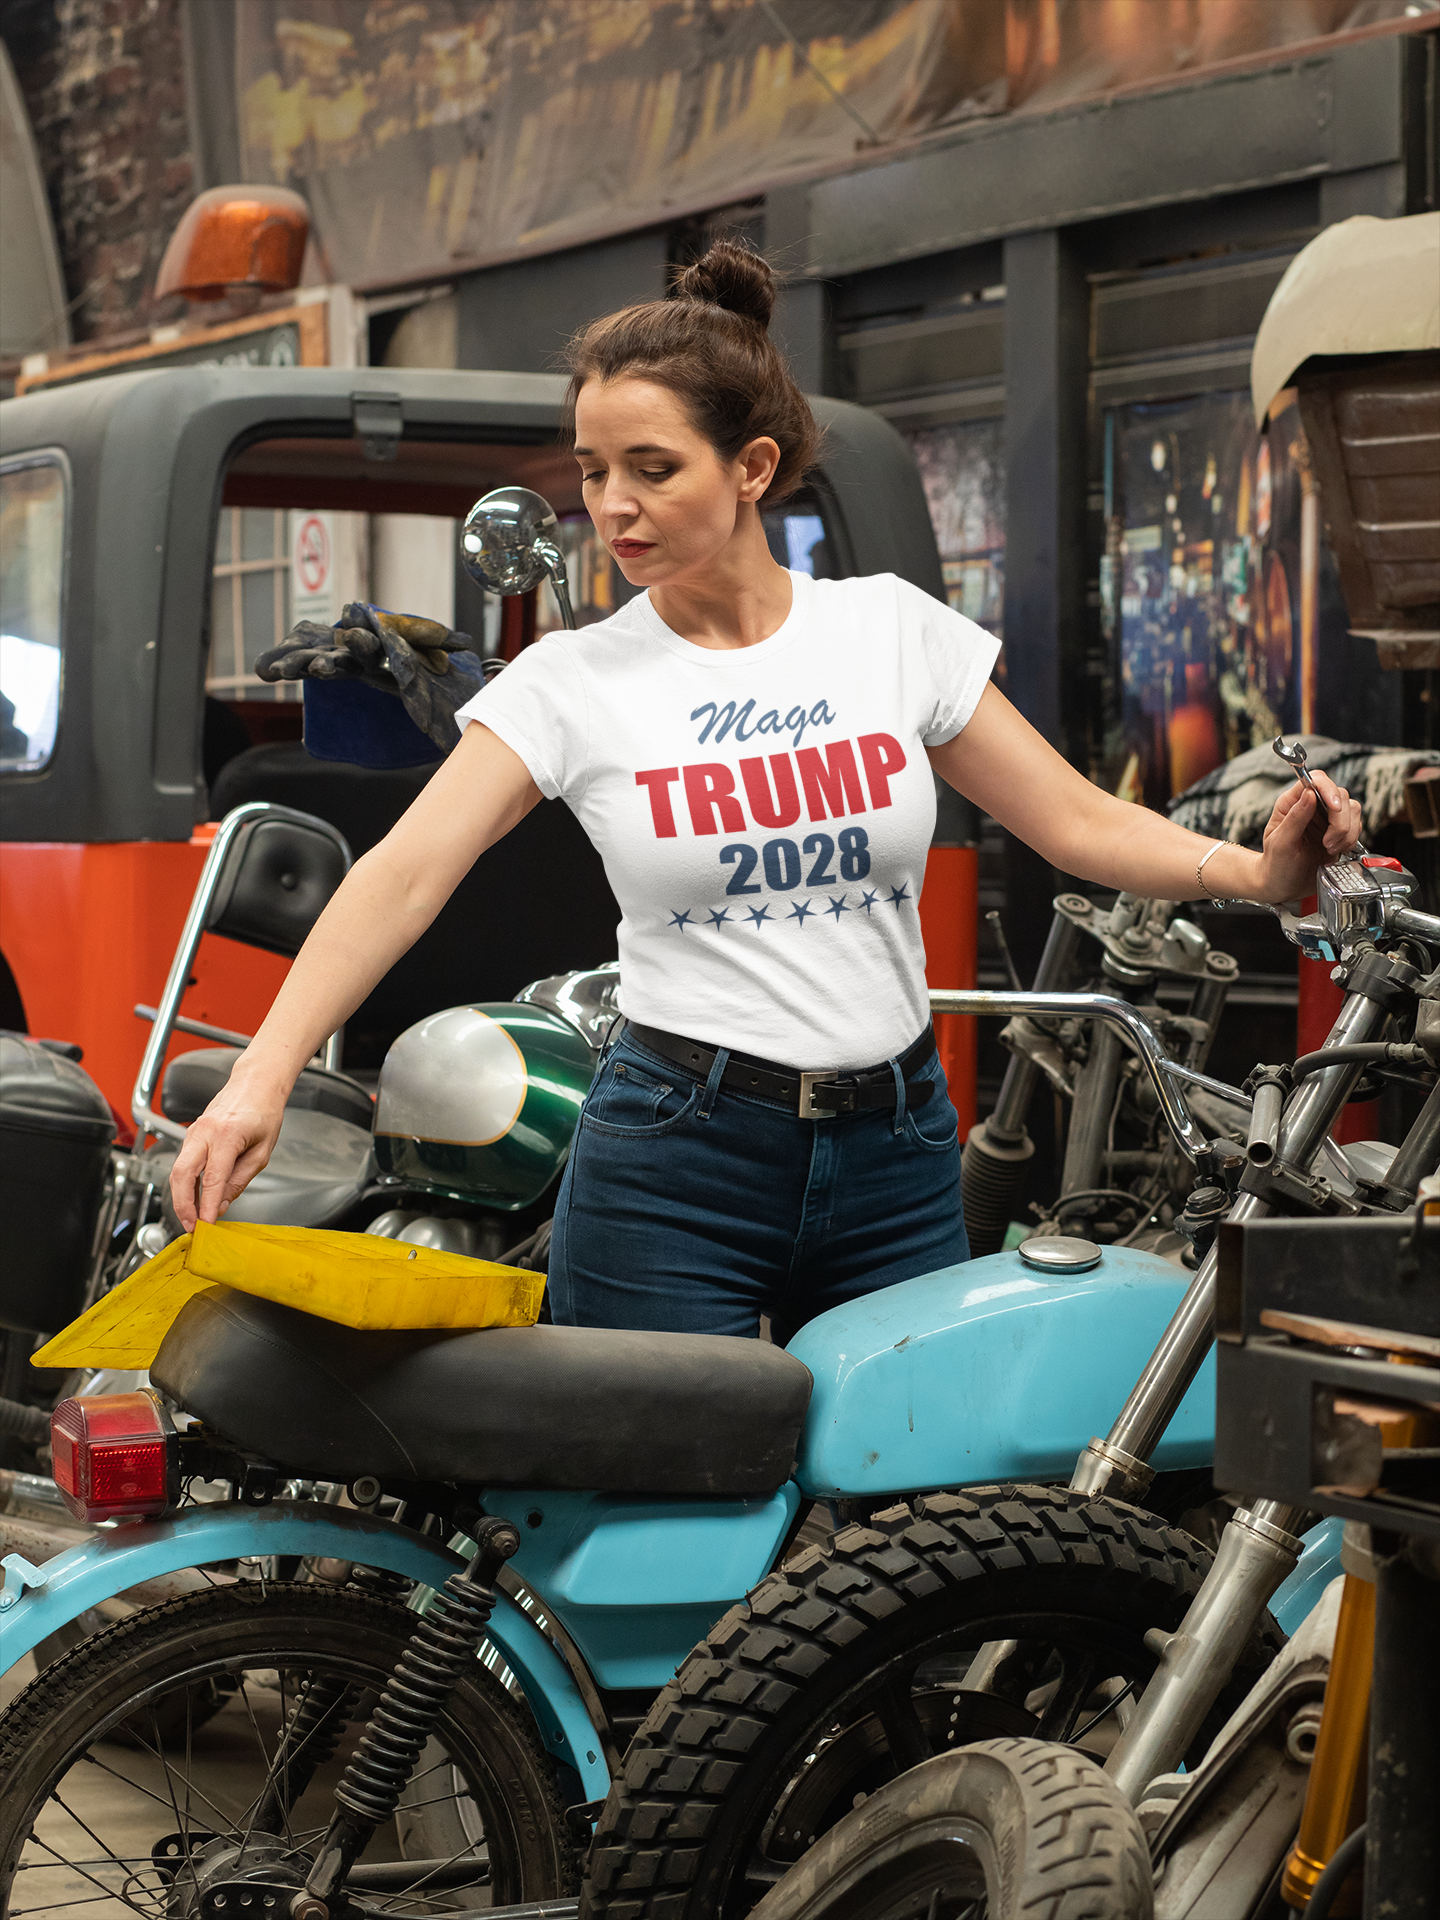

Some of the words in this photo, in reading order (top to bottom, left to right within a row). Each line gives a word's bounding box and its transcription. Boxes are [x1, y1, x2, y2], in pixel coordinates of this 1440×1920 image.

[690, 698, 837, 748] Maga
[635, 732, 907, 839] TRUMP
[719, 826, 871, 896] 2028
